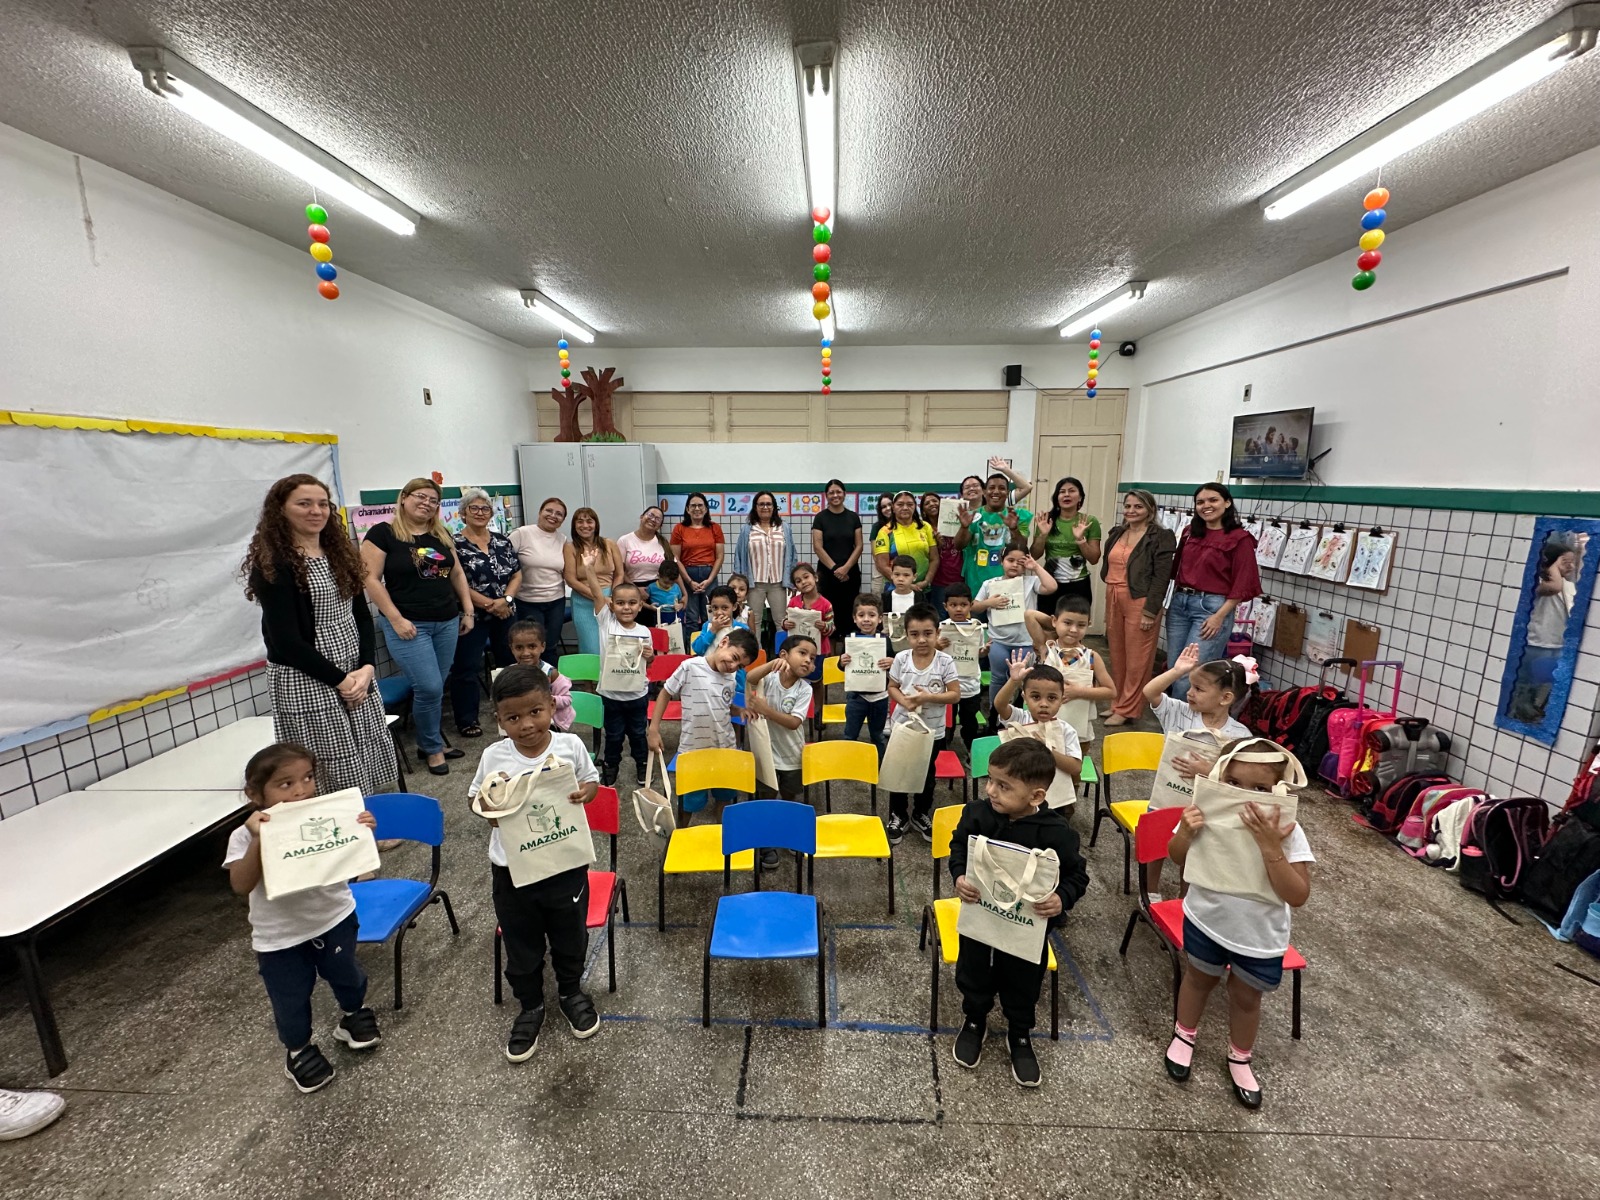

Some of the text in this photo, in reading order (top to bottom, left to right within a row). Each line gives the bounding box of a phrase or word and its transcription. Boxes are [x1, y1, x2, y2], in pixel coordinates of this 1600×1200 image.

[727, 497, 737, 512] 2
[792, 497, 801, 511] 4
[1166, 781, 1194, 795] AMAZ
[282, 834, 359, 860] AMAZÔNIA
[519, 825, 578, 853] AMAZÔNIA
[975, 898, 1034, 927] AMAZÔNIA
